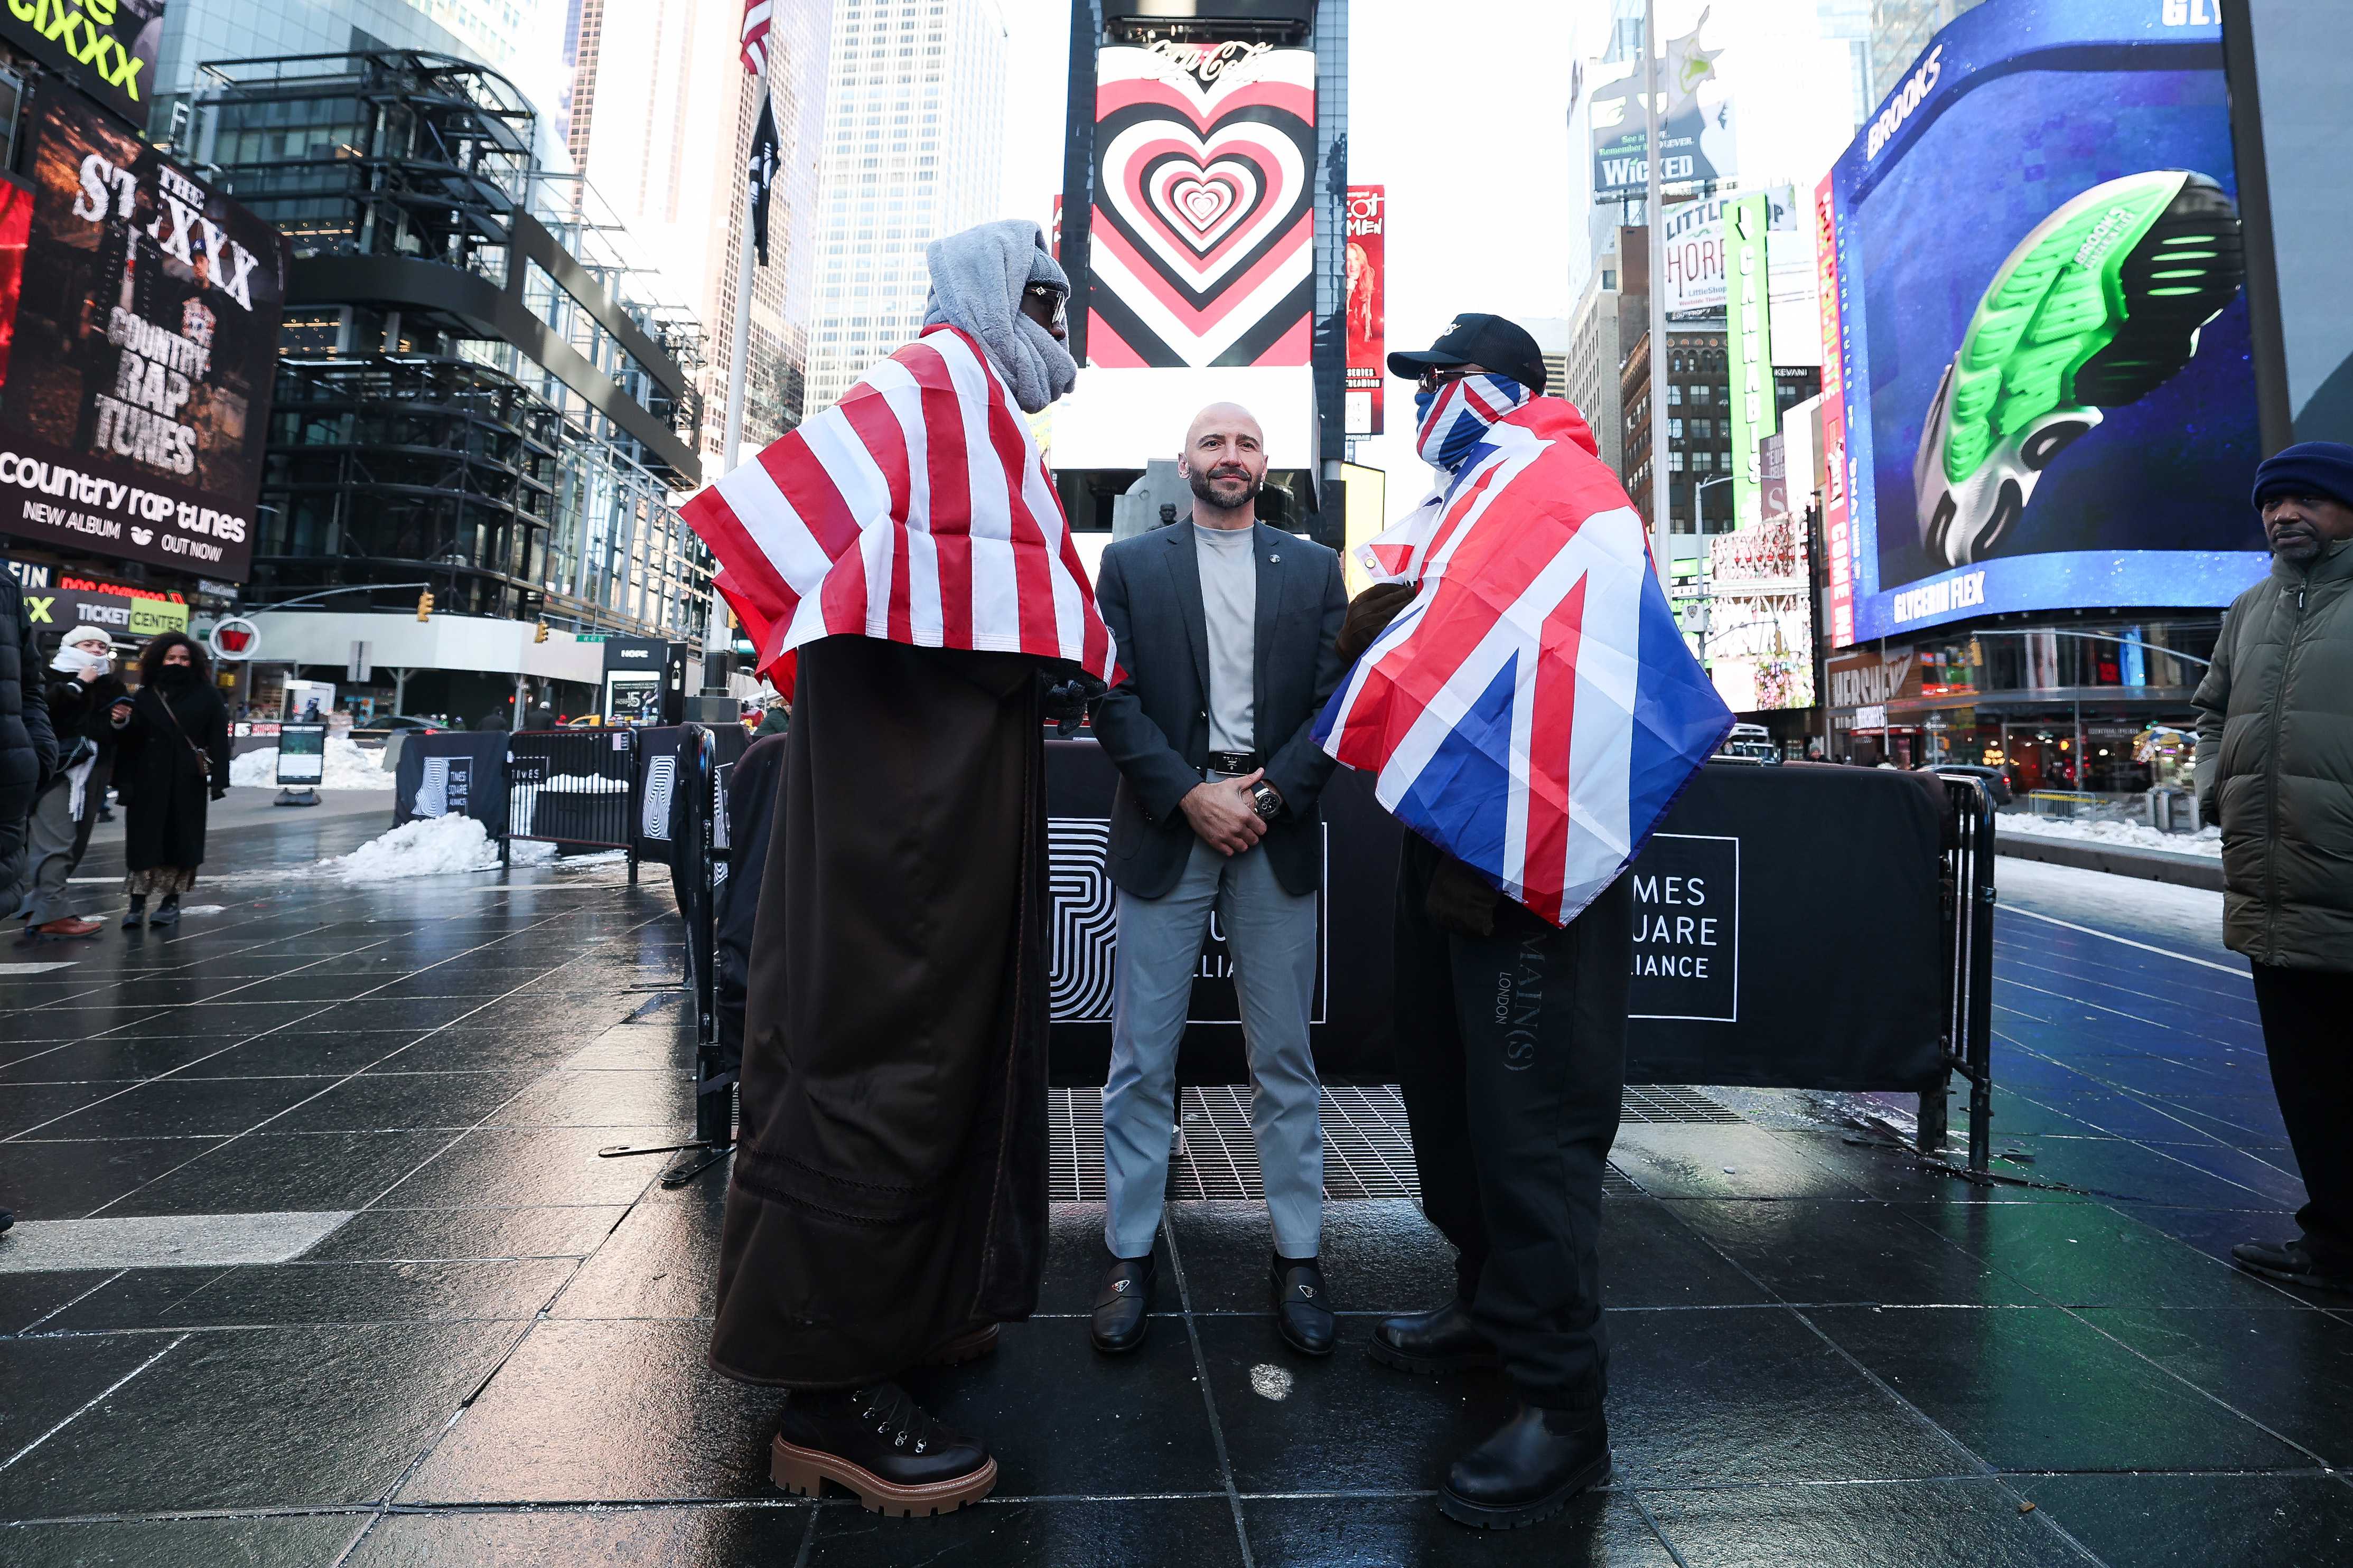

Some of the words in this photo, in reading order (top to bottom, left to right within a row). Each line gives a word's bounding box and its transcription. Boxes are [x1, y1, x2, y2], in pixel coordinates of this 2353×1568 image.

[1867, 43, 1943, 162] BROOKS
[1599, 143, 1641, 156] Remember
[157, 163, 205, 210] THE
[107, 306, 211, 381] COUNTRY
[1739, 245, 1761, 484] CANNABIS
[114, 348, 191, 418] RAP
[1346, 379, 1380, 388] REAMING
[95, 393, 197, 475] TUNES
[0, 452, 128, 510] country
[176, 500, 247, 543] tunes
[22, 500, 67, 526] NEW
[65, 511, 122, 540] ALBUM
[161, 534, 191, 555] OUT
[189, 541, 223, 562] NOW
[1831, 521, 1850, 600] COME
[24, 597, 55, 623] X
[77, 603, 130, 626] TICKET
[134, 612, 183, 630] CENTER
[1893, 580, 1949, 624] GLYCERIN
[1950, 570, 1986, 610] FLEX
[627, 692, 640, 707] 15
[1631, 954, 1708, 978] IANCE
[1495, 972, 1512, 1025] LONDON
